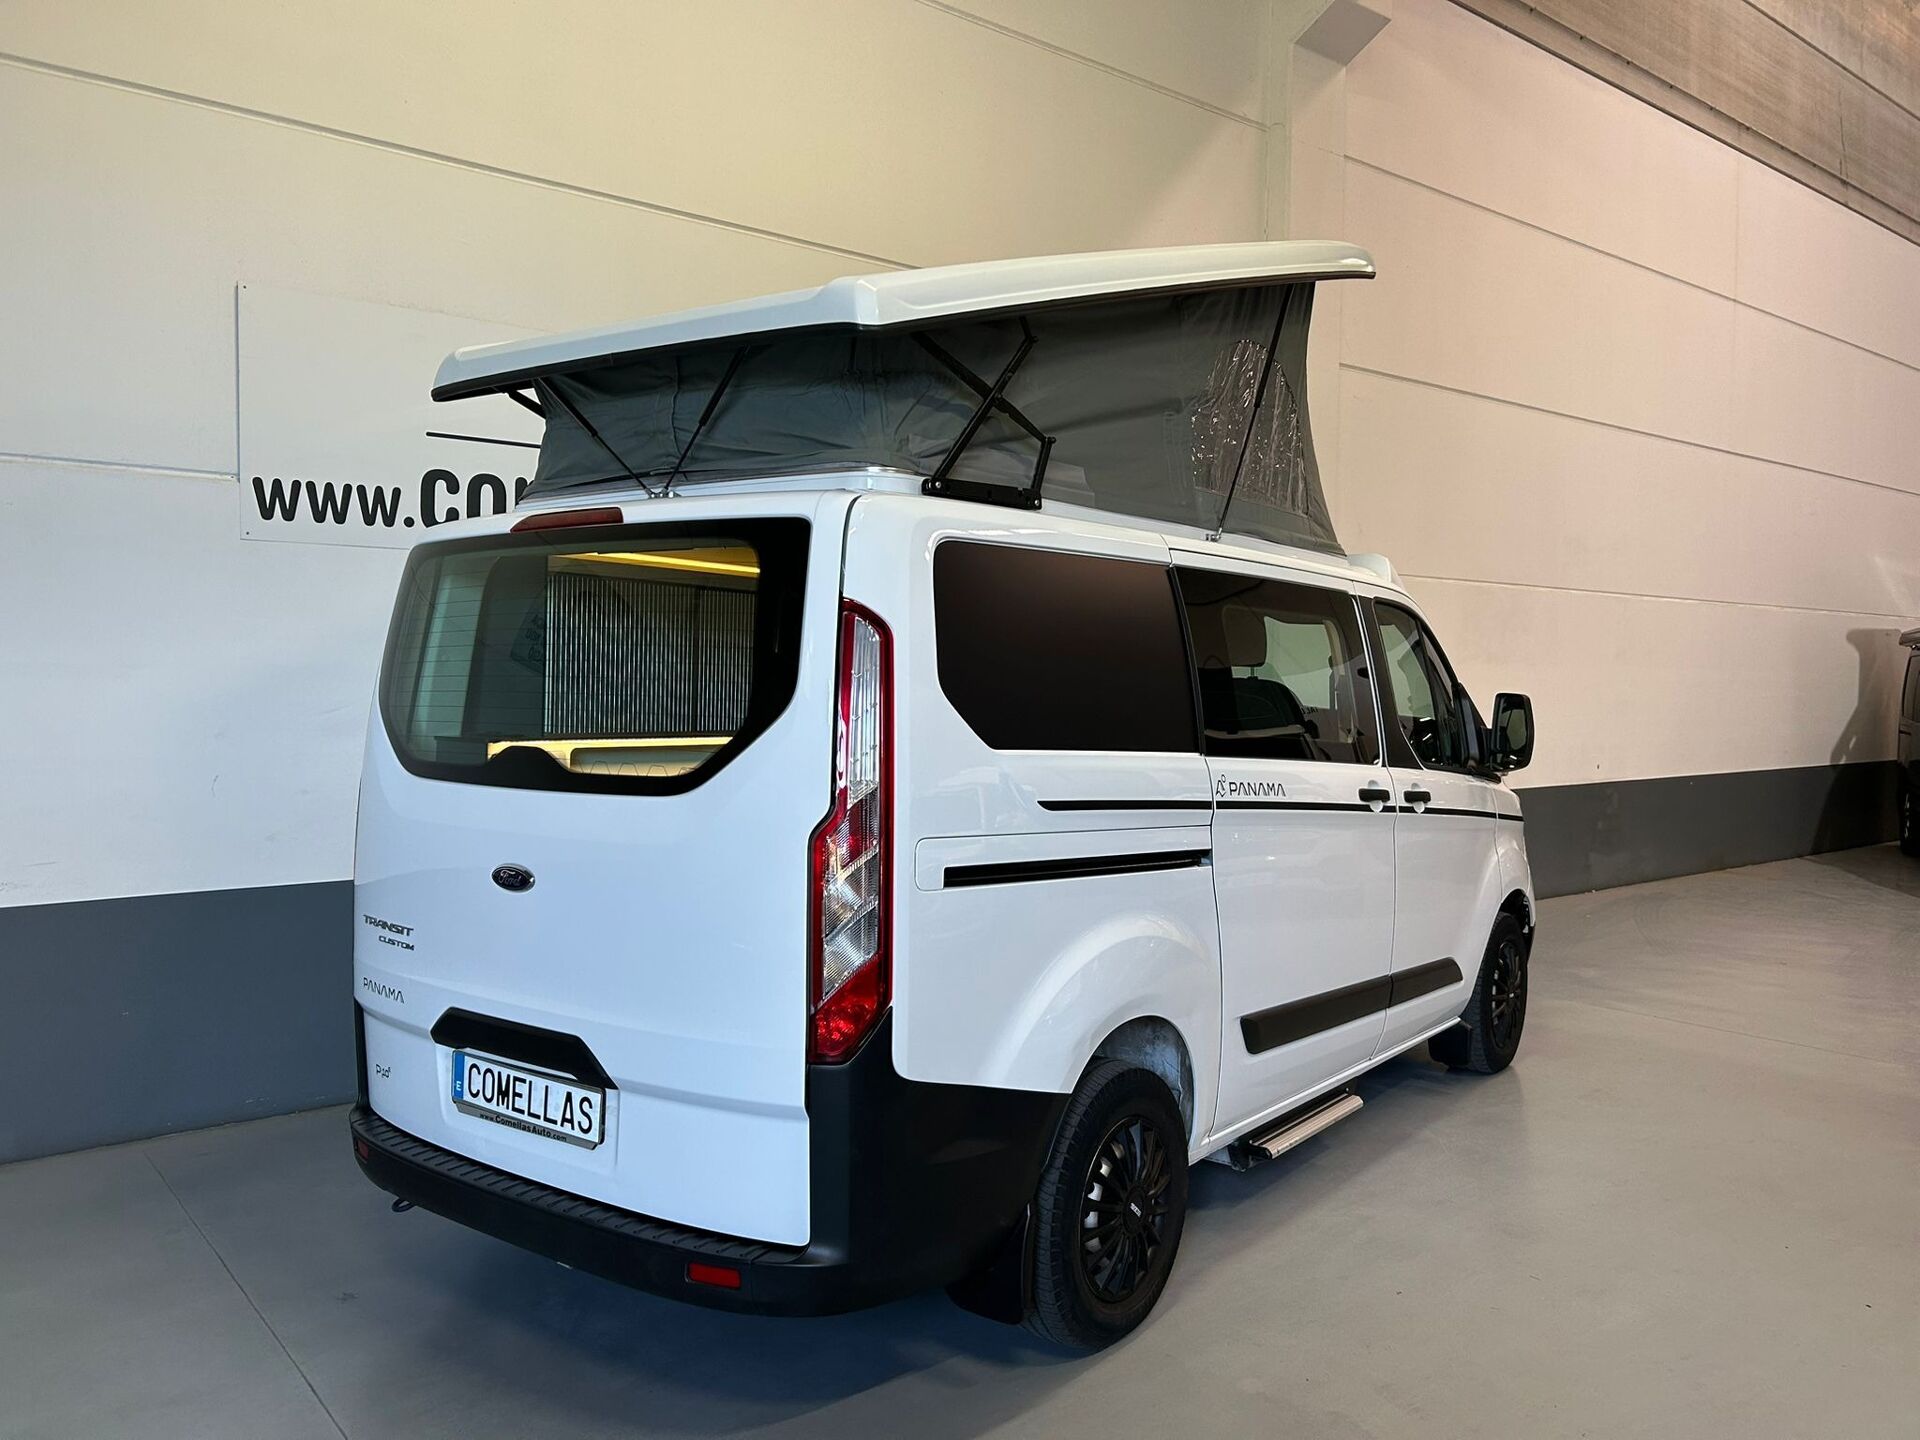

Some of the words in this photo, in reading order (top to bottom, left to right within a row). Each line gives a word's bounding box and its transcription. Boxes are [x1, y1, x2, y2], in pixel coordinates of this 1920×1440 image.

[1229, 782, 1286, 797] PANAMA
[363, 914, 414, 937] TRANSIT
[378, 935, 415, 951] CUSTOM
[363, 977, 405, 1004] PANAMA
[455, 1080, 462, 1091] E
[468, 1063, 593, 1134] COMELLAS
[479, 1114, 567, 1142] www.ComellasAuto.com
